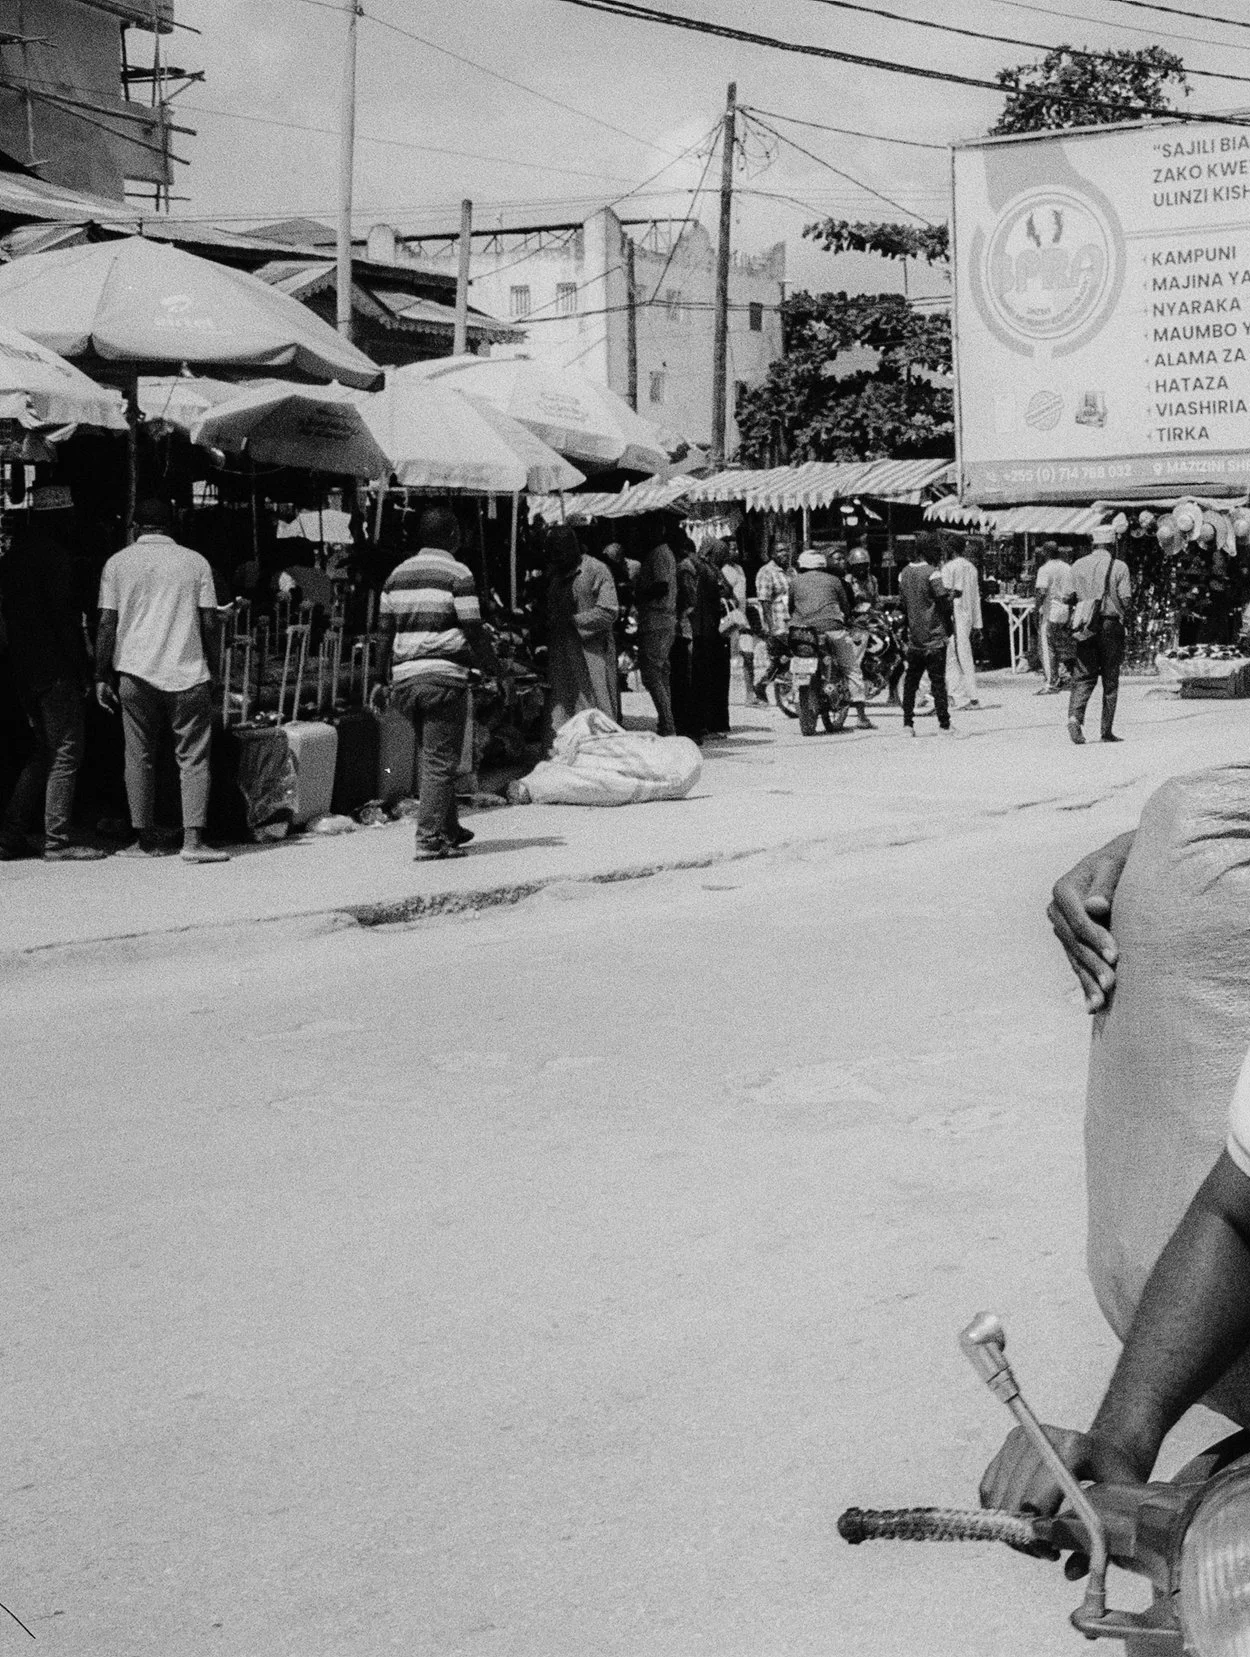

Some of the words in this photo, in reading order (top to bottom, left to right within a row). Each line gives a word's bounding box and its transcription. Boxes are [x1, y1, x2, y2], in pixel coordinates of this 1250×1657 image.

[1153, 164, 1202, 184] ZAKO
[1153, 188, 1209, 207] ULINZI
[1152, 246, 1236, 267] KAMPUNI
[1153, 272, 1224, 292] MAJINA
[1153, 297, 1242, 318] NYARAKA
[1154, 322, 1237, 342] MAUMBO
[1155, 349, 1218, 368] ALAMA
[1223, 347, 1247, 364] ZA
[1155, 376, 1229, 394] HATAZA
[1156, 398, 1248, 418] VIASHIRIA
[1157, 426, 1210, 443] TIRKA
[1003, 468, 1034, 483] +255
[1036, 467, 1056, 484] (0)
[1059, 466, 1079, 480] 714
[1167, 460, 1225, 474] MAZIZINI
